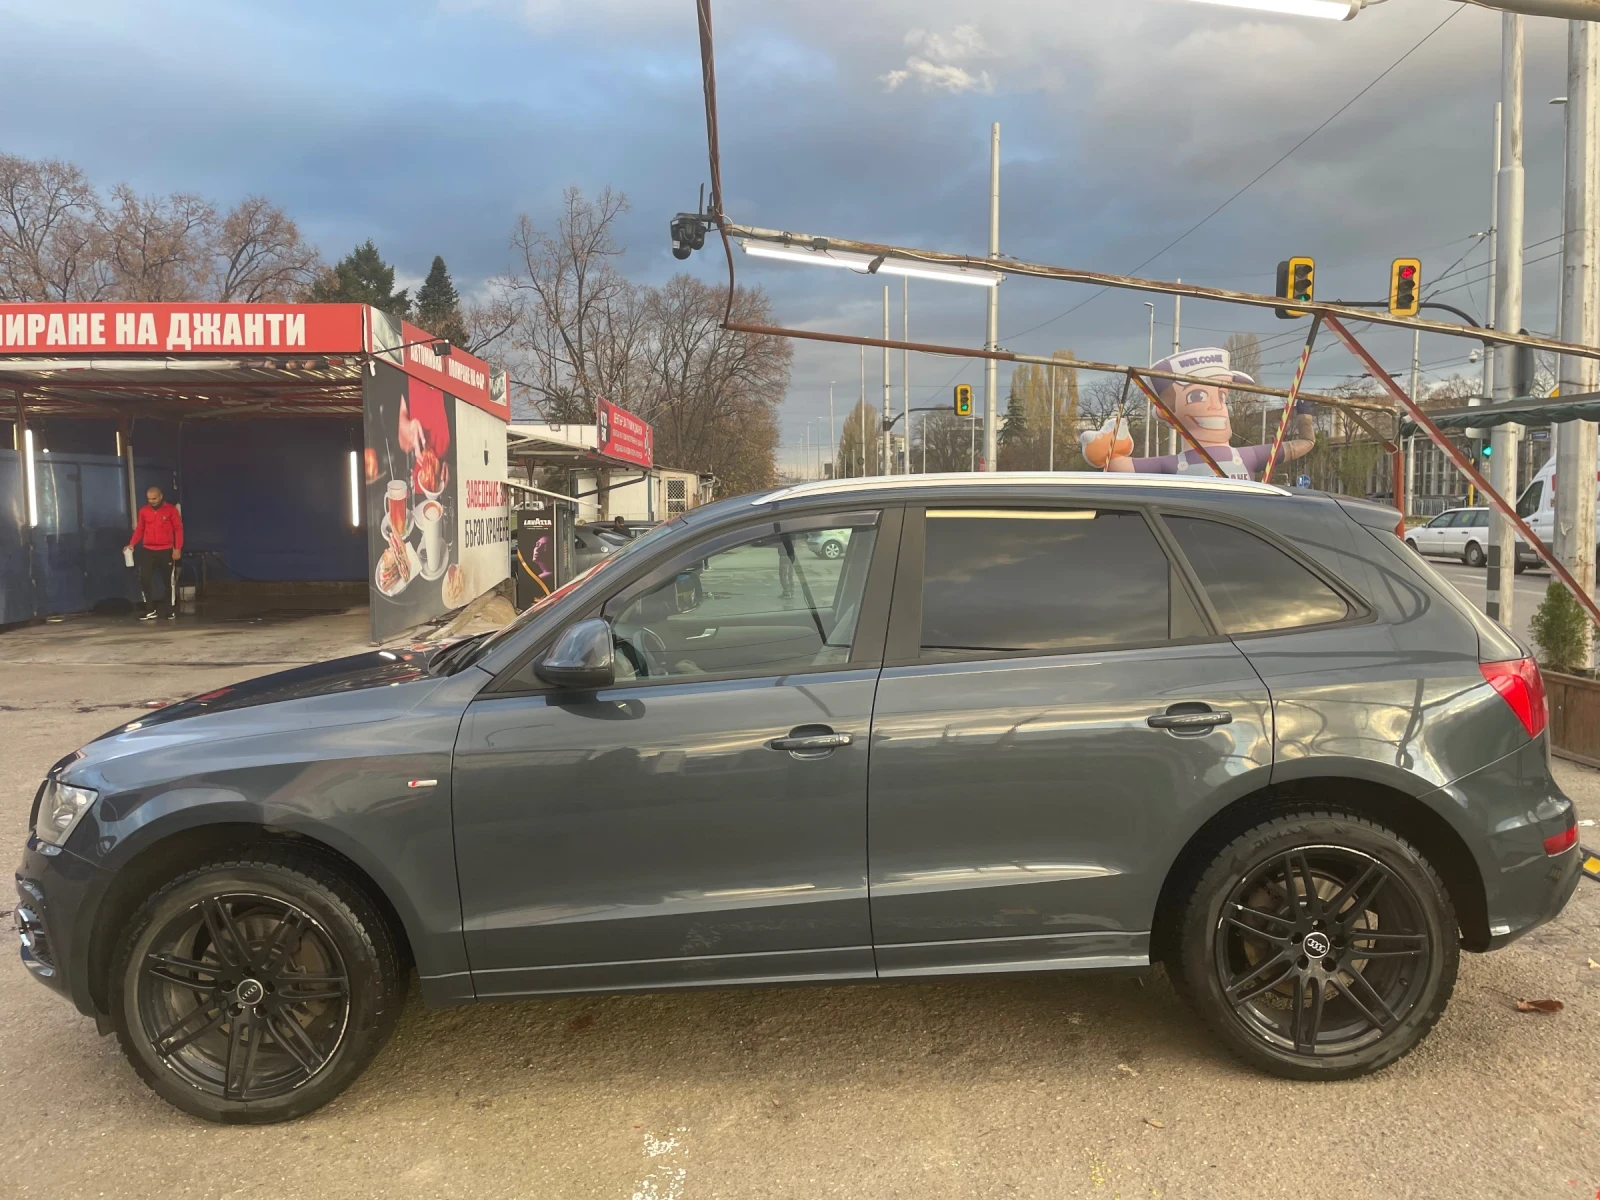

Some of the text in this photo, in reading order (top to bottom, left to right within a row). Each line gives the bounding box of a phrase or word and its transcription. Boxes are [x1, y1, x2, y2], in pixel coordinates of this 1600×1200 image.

[0, 313, 305, 350] ИРАНЕ НА ДЖАНТИ
[1178, 354, 1223, 369] WELCOME
[466, 480, 499, 511] ЗАВЕДЕНИЕ
[465, 519, 485, 548] БЪРЗО
[523, 517, 552, 526] LAVAZZA
